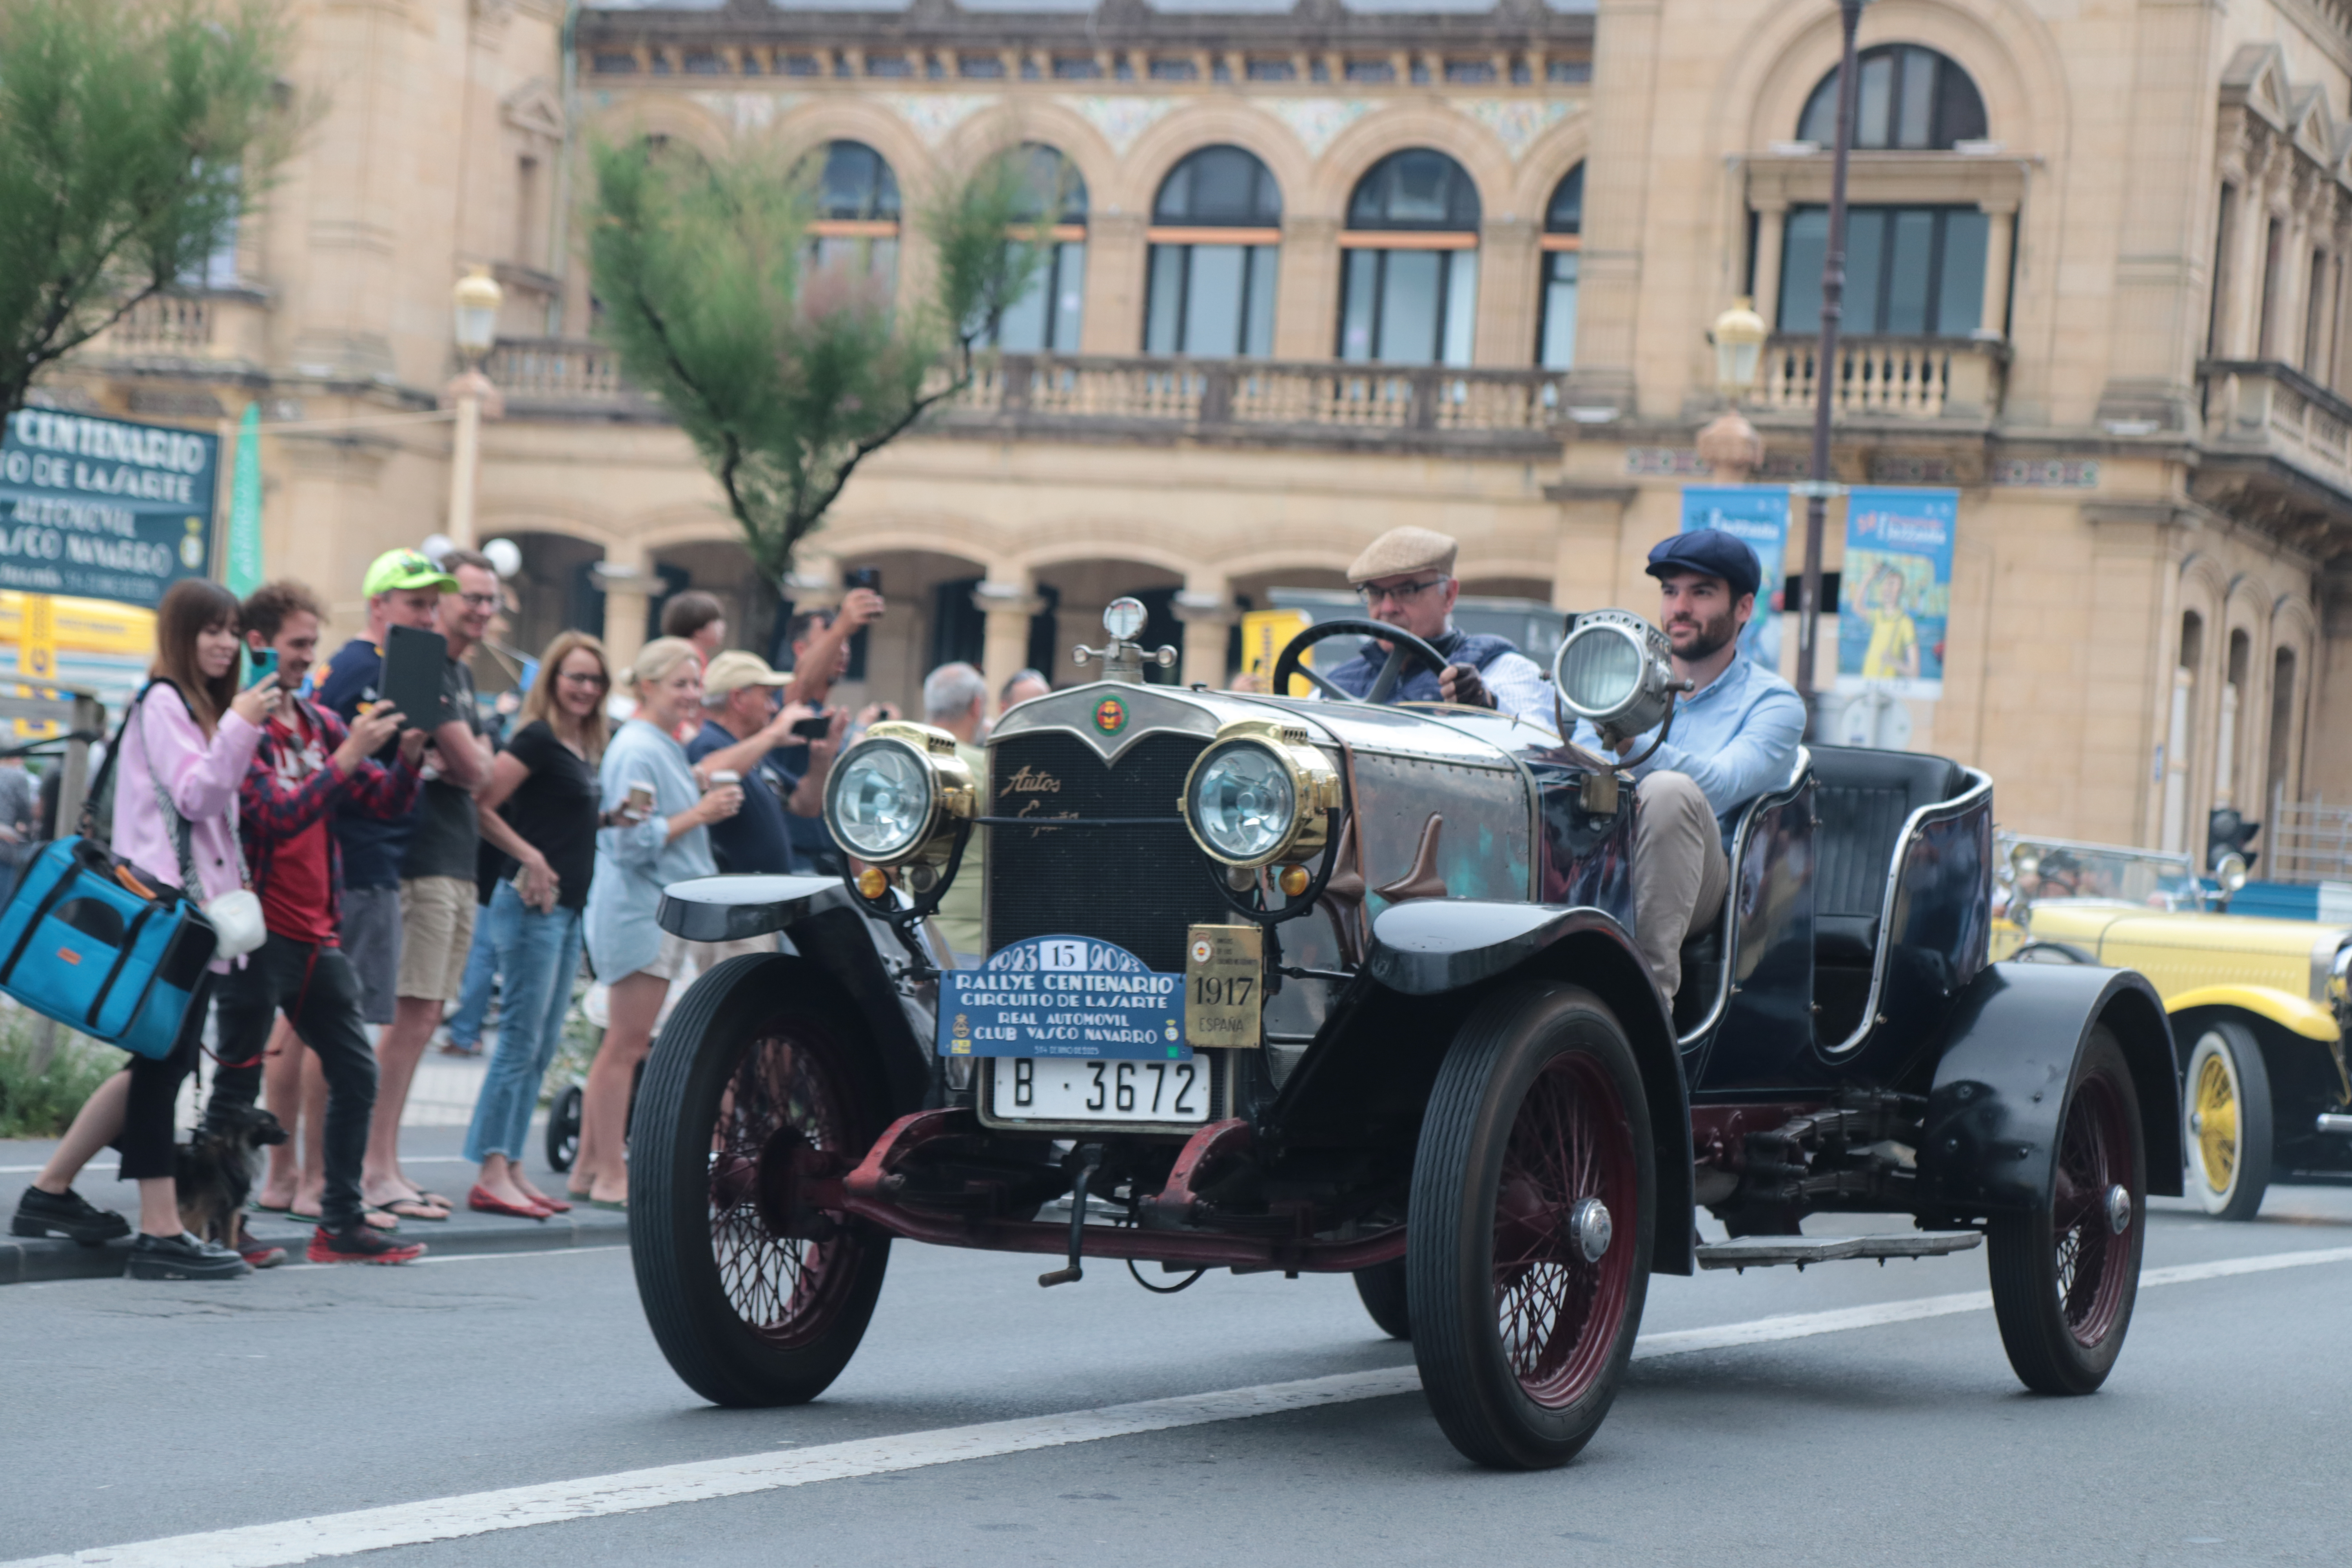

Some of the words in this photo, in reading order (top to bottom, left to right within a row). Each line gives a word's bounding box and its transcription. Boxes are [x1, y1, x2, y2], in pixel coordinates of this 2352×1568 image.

[16, 408, 206, 474] CENTENARIO
[32, 453, 70, 488] DE
[66, 533, 173, 579] NAVARRO
[999, 765, 1061, 798] Autos
[988, 944, 1038, 972] 1923
[1052, 945, 1074, 967] 15
[1090, 944, 1140, 973] 2023
[956, 975, 1036, 990] RALLYE
[1043, 975, 1174, 994] CENTENARIO
[1194, 977, 1254, 1006] 1917
[960, 993, 1054, 1007] CIRCUITO
[1057, 994, 1080, 1007] DE
[1085, 995, 1168, 1009] LASARTE
[998, 1012, 1038, 1025] REAL
[1045, 1013, 1130, 1027] AUTOMOVIL
[1199, 1017, 1244, 1032] ESPAÑA
[974, 1026, 1017, 1041] CLUB
[1026, 1027, 1079, 1040] VASCO
[1085, 1029, 1158, 1044] NAVARRO
[1015, 1058, 1033, 1106] B
[1087, 1062, 1195, 1113] 3672
